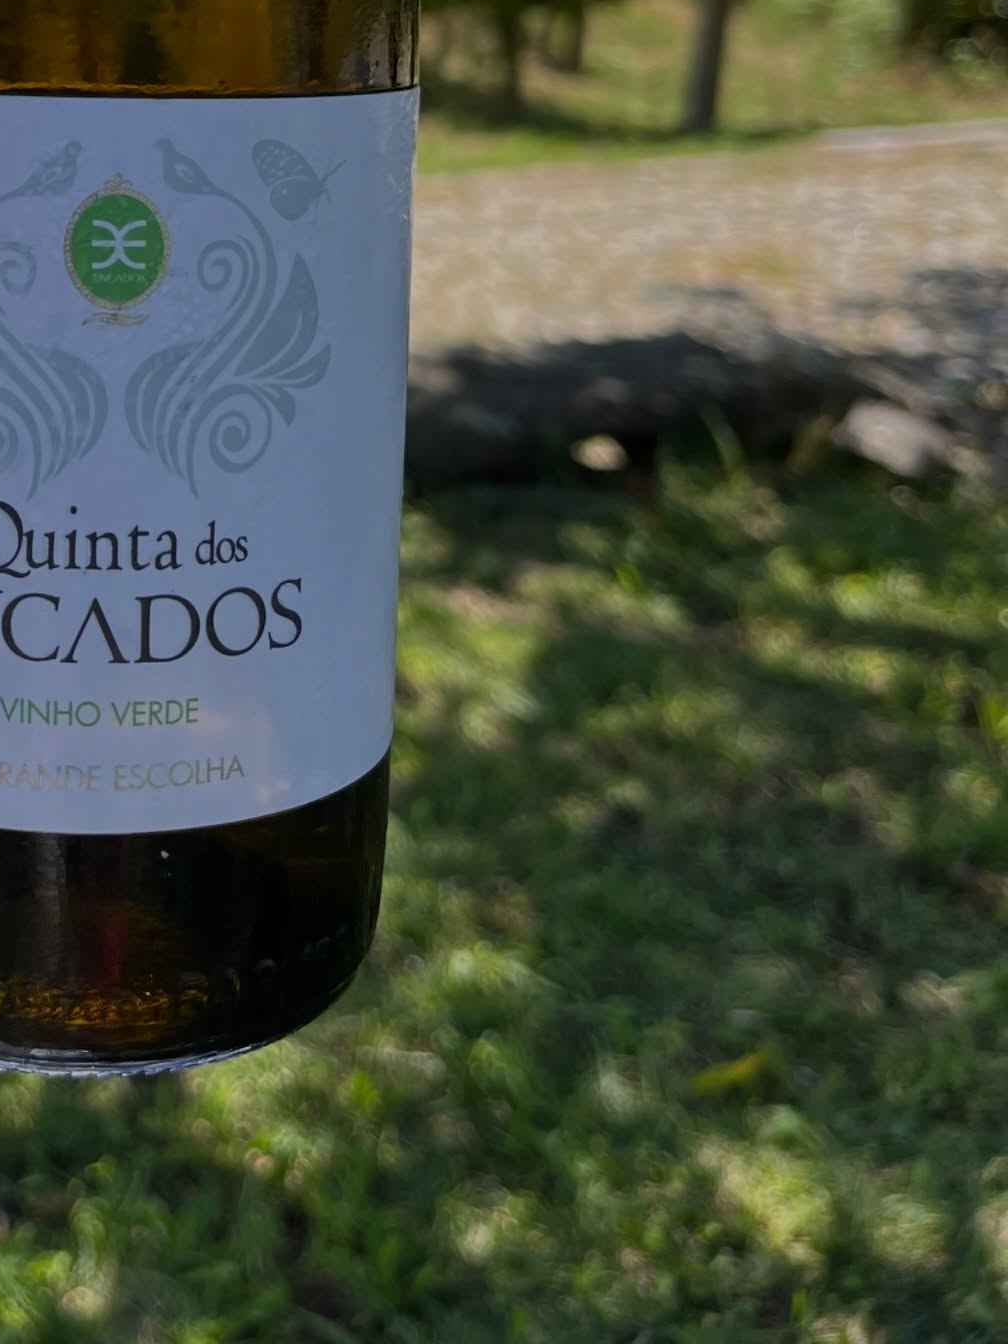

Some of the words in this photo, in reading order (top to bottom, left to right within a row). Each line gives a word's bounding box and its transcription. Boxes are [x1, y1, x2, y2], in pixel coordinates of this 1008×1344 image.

[195, 520, 249, 566] dos
[111, 697, 200, 727] VERDE
[113, 754, 246, 791] ESCOLHA
